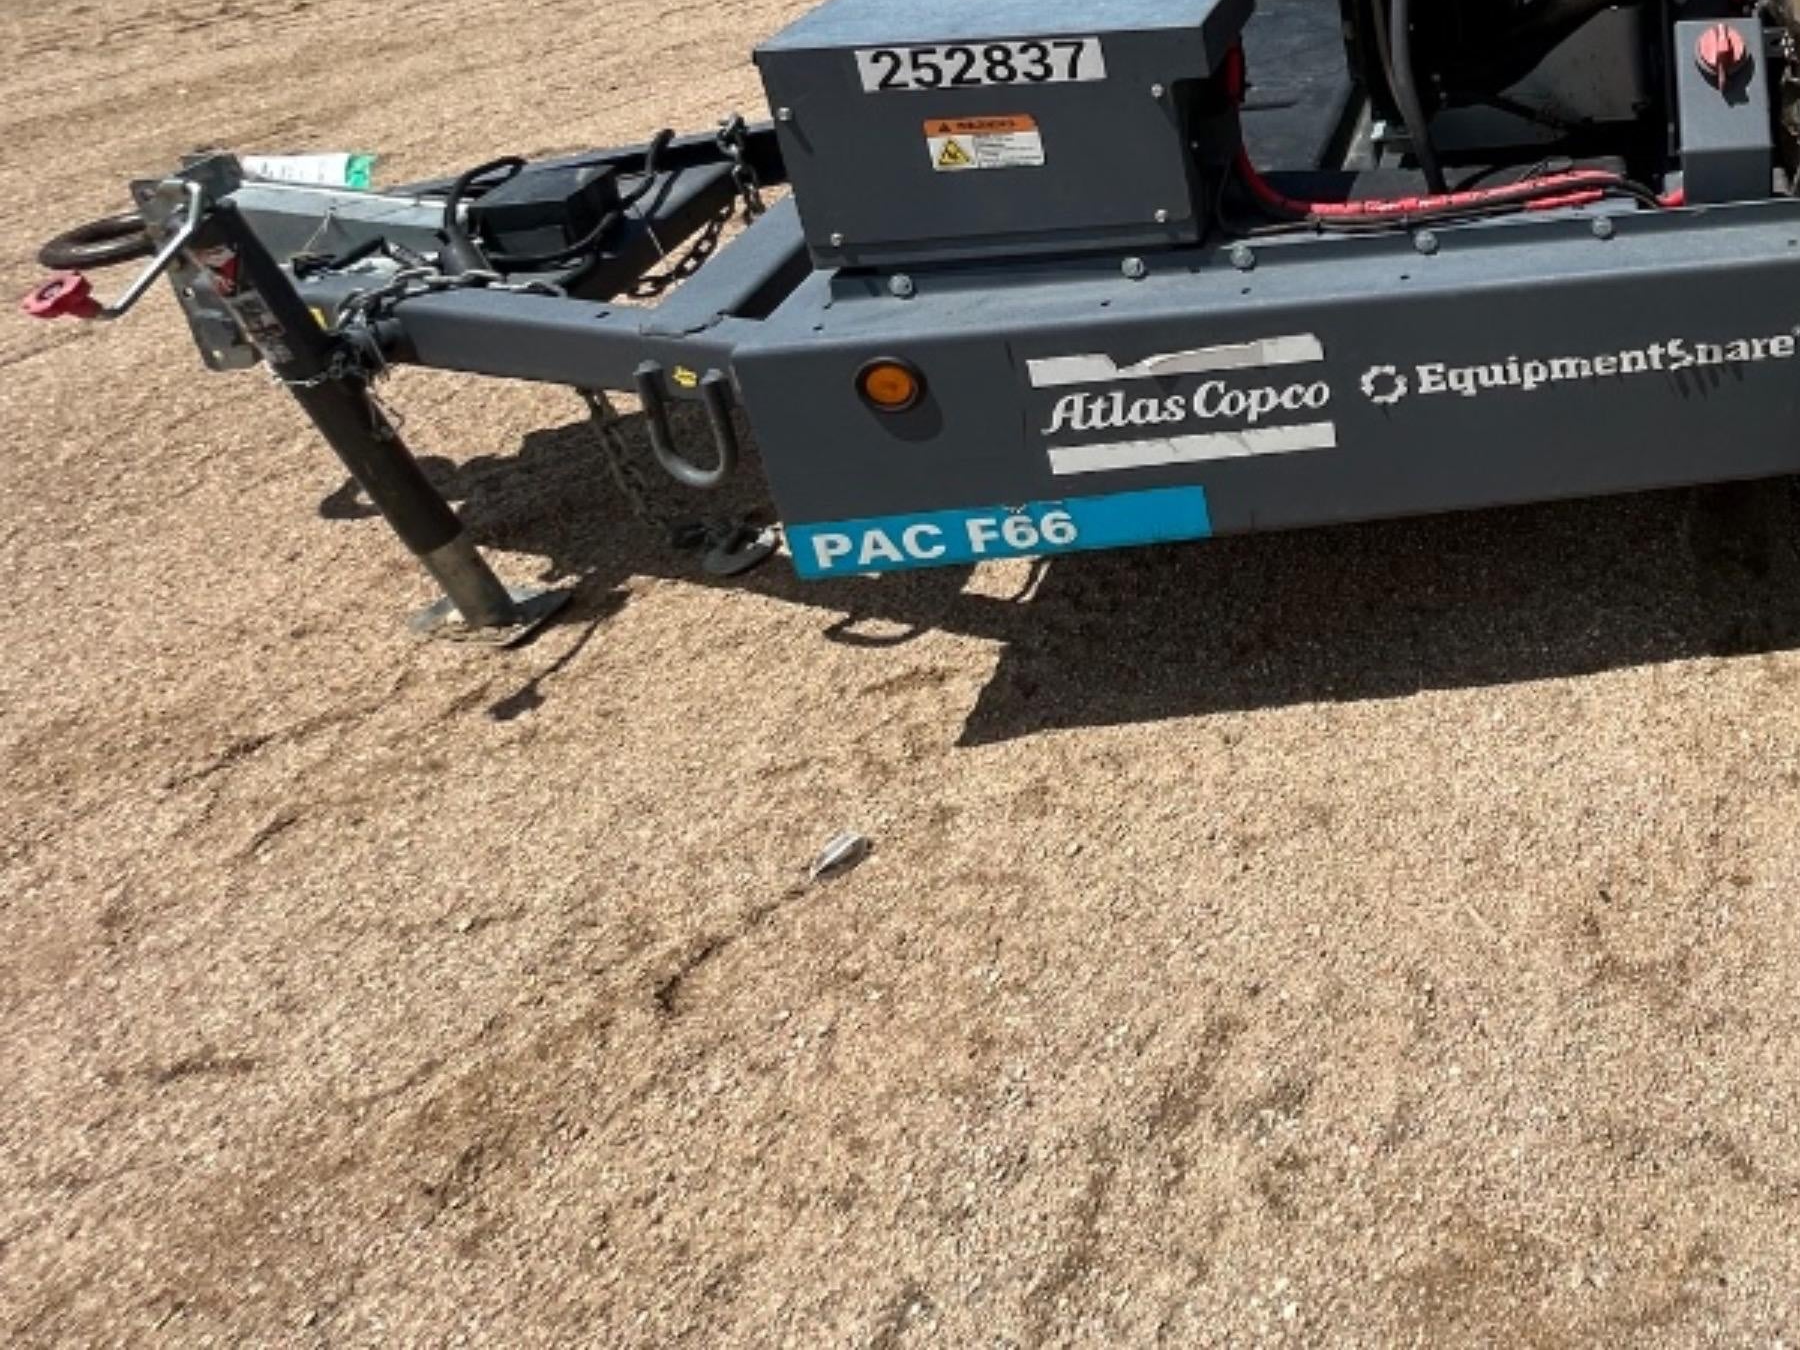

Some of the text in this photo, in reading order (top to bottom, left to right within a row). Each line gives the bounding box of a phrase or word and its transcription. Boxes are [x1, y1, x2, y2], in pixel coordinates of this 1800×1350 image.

[870, 39, 1086, 90] 252837
[1041, 379, 1331, 435] Atlas Copco
[811, 508, 1078, 569] PAC F66
